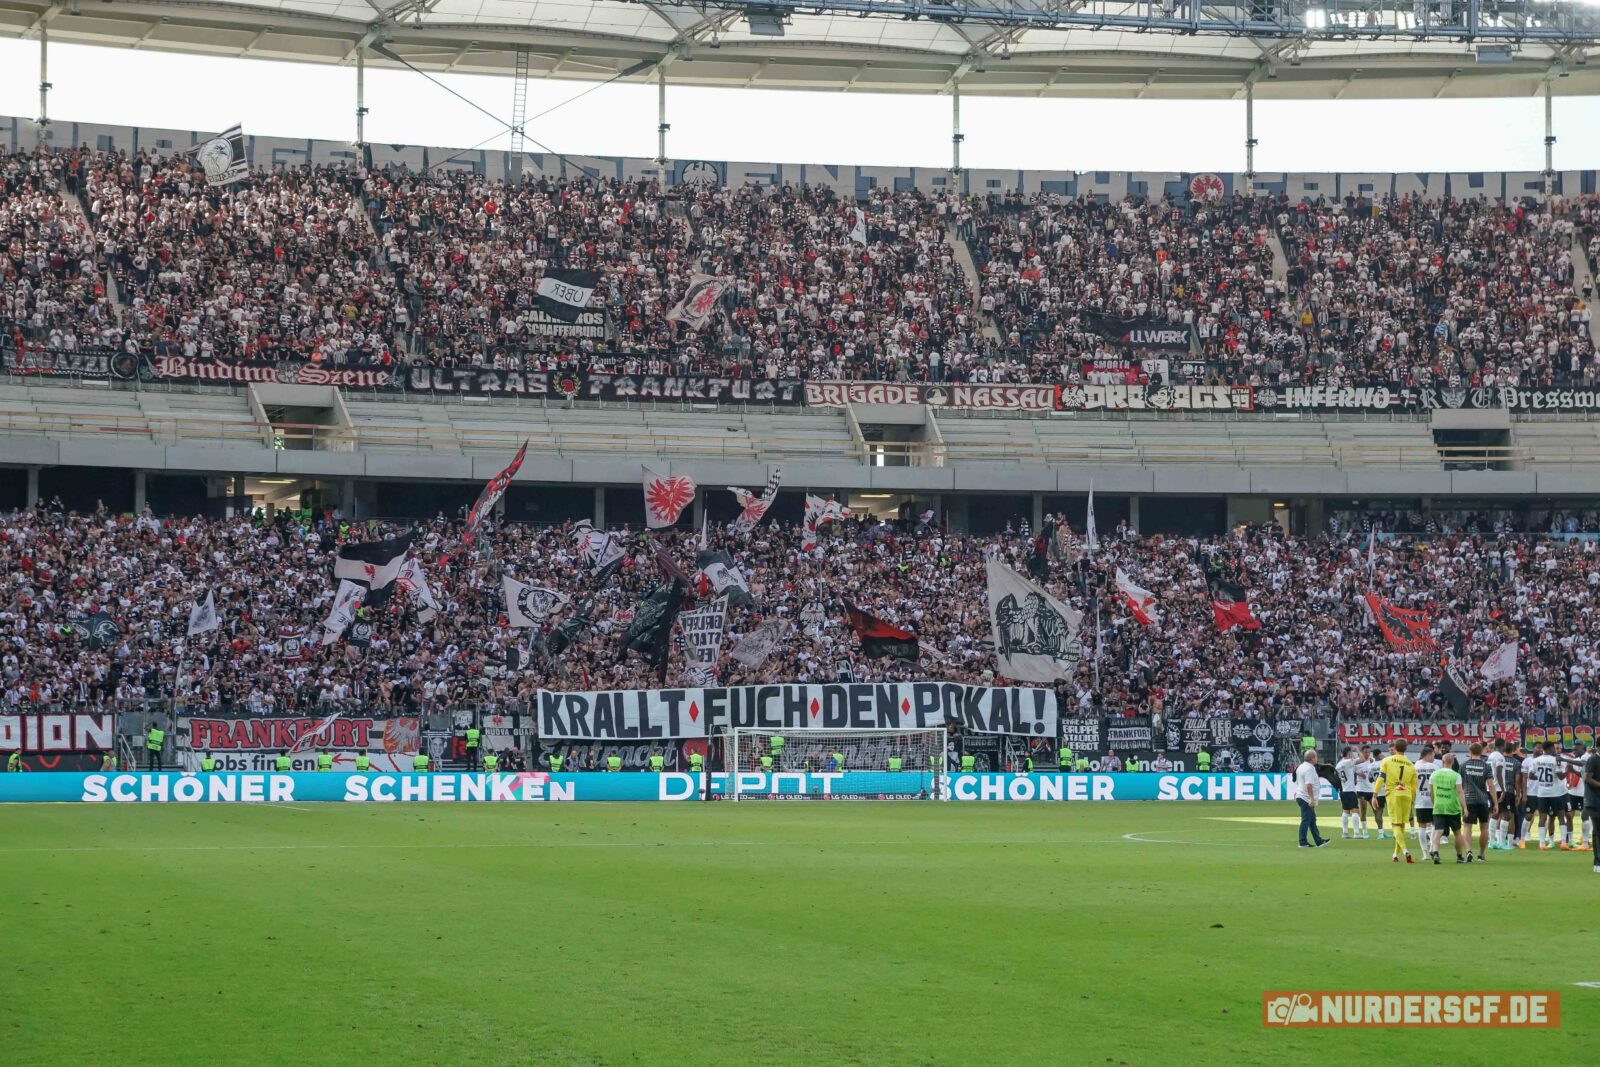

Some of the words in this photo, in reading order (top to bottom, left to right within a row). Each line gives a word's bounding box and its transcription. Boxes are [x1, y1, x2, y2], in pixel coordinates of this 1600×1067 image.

[155, 355, 279, 384] Binding
[298, 363, 389, 387] Szene
[410, 367, 549, 393] ULTRAS
[806, 384, 918, 405] BRIGADE
[954, 385, 1056, 410] NASSAU
[1285, 387, 1391, 409] INFERNO
[542, 690, 685, 738] KRALLT
[703, 685, 804, 728] EUCH
[822, 684, 898, 728] DEN
[912, 682, 1047, 735] POKAL!
[1183, 719, 1208, 729] FULDA
[1344, 721, 1497, 738] EINTRACHT
[1069, 741, 1099, 750] ERBOT
[212, 755, 247, 772] obs
[251, 754, 315, 772] finen
[1399, 765, 1405, 780] 1
[1537, 766, 1554, 783] 26
[81, 772, 295, 802] SCHÖNER
[343, 773, 575, 801] SCHENKEN
[658, 772, 844, 801] DEPOT
[930, 772, 1115, 802] SCHÖNER
